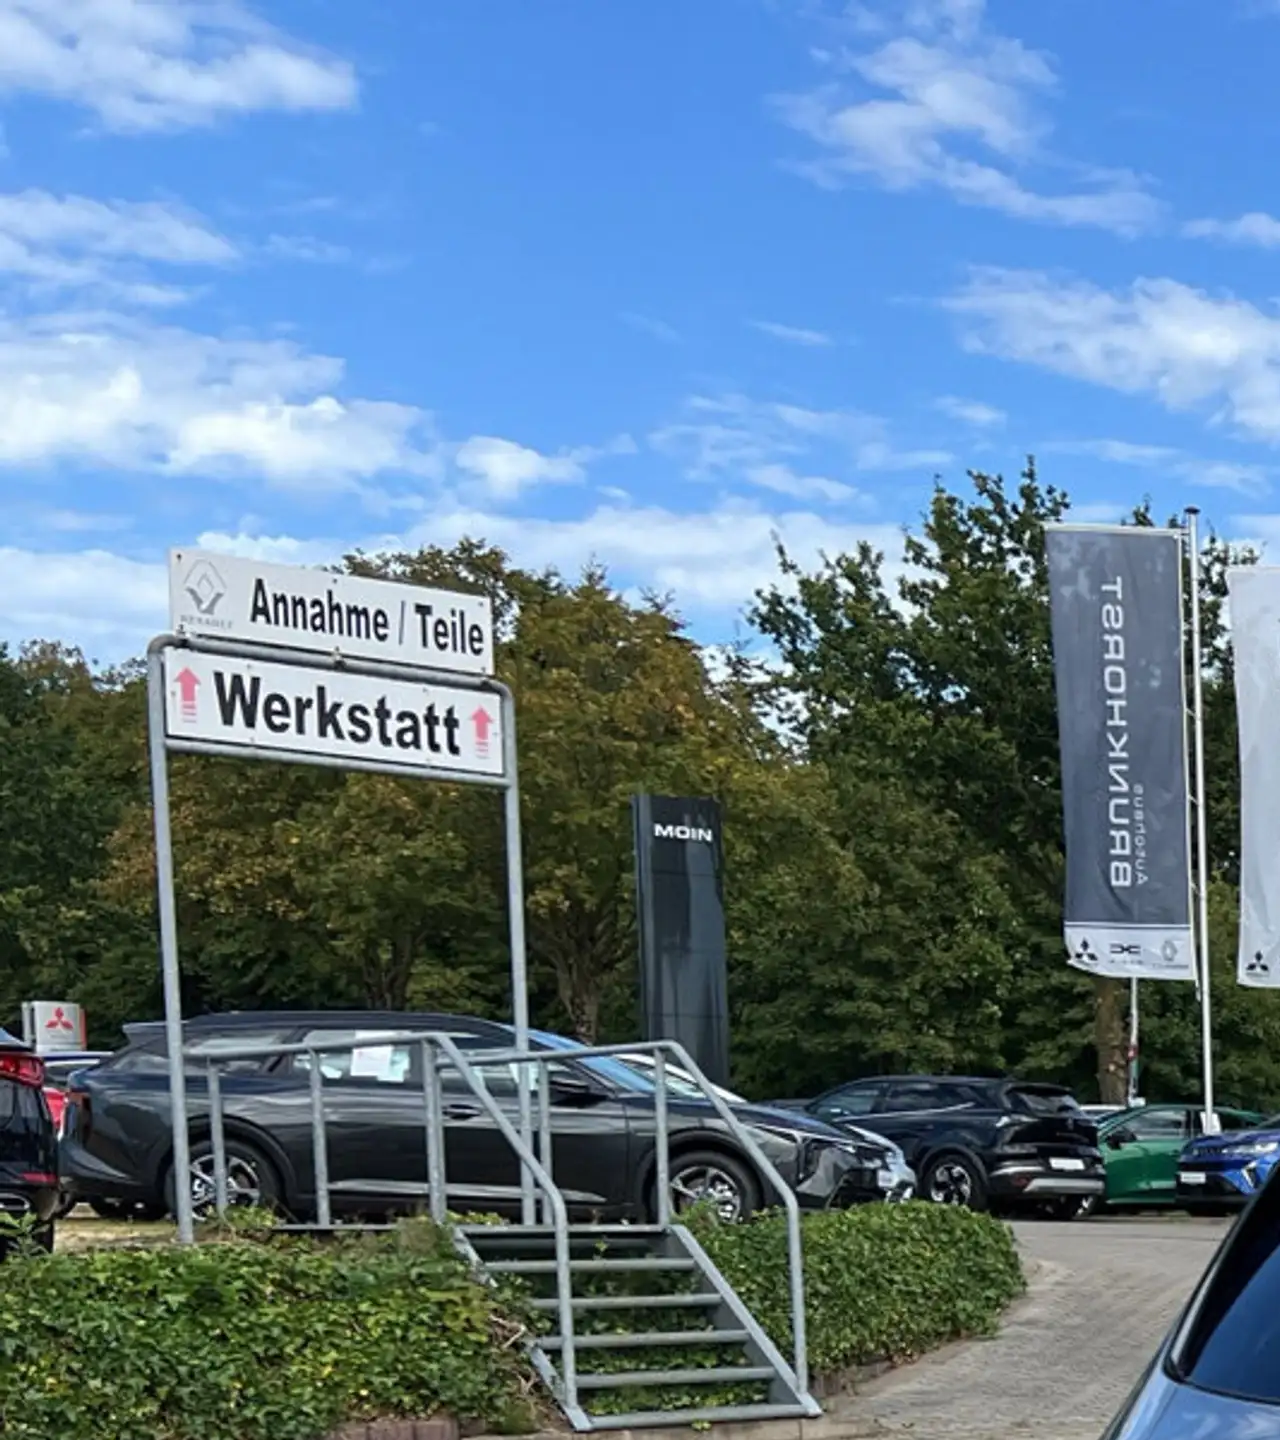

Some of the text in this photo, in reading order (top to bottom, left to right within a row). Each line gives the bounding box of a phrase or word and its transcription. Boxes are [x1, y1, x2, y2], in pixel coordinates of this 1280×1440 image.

[250, 577, 485, 656] Annahme / Teile
[212, 671, 461, 756] Werkstatt
[653, 823, 713, 842] MOIN
